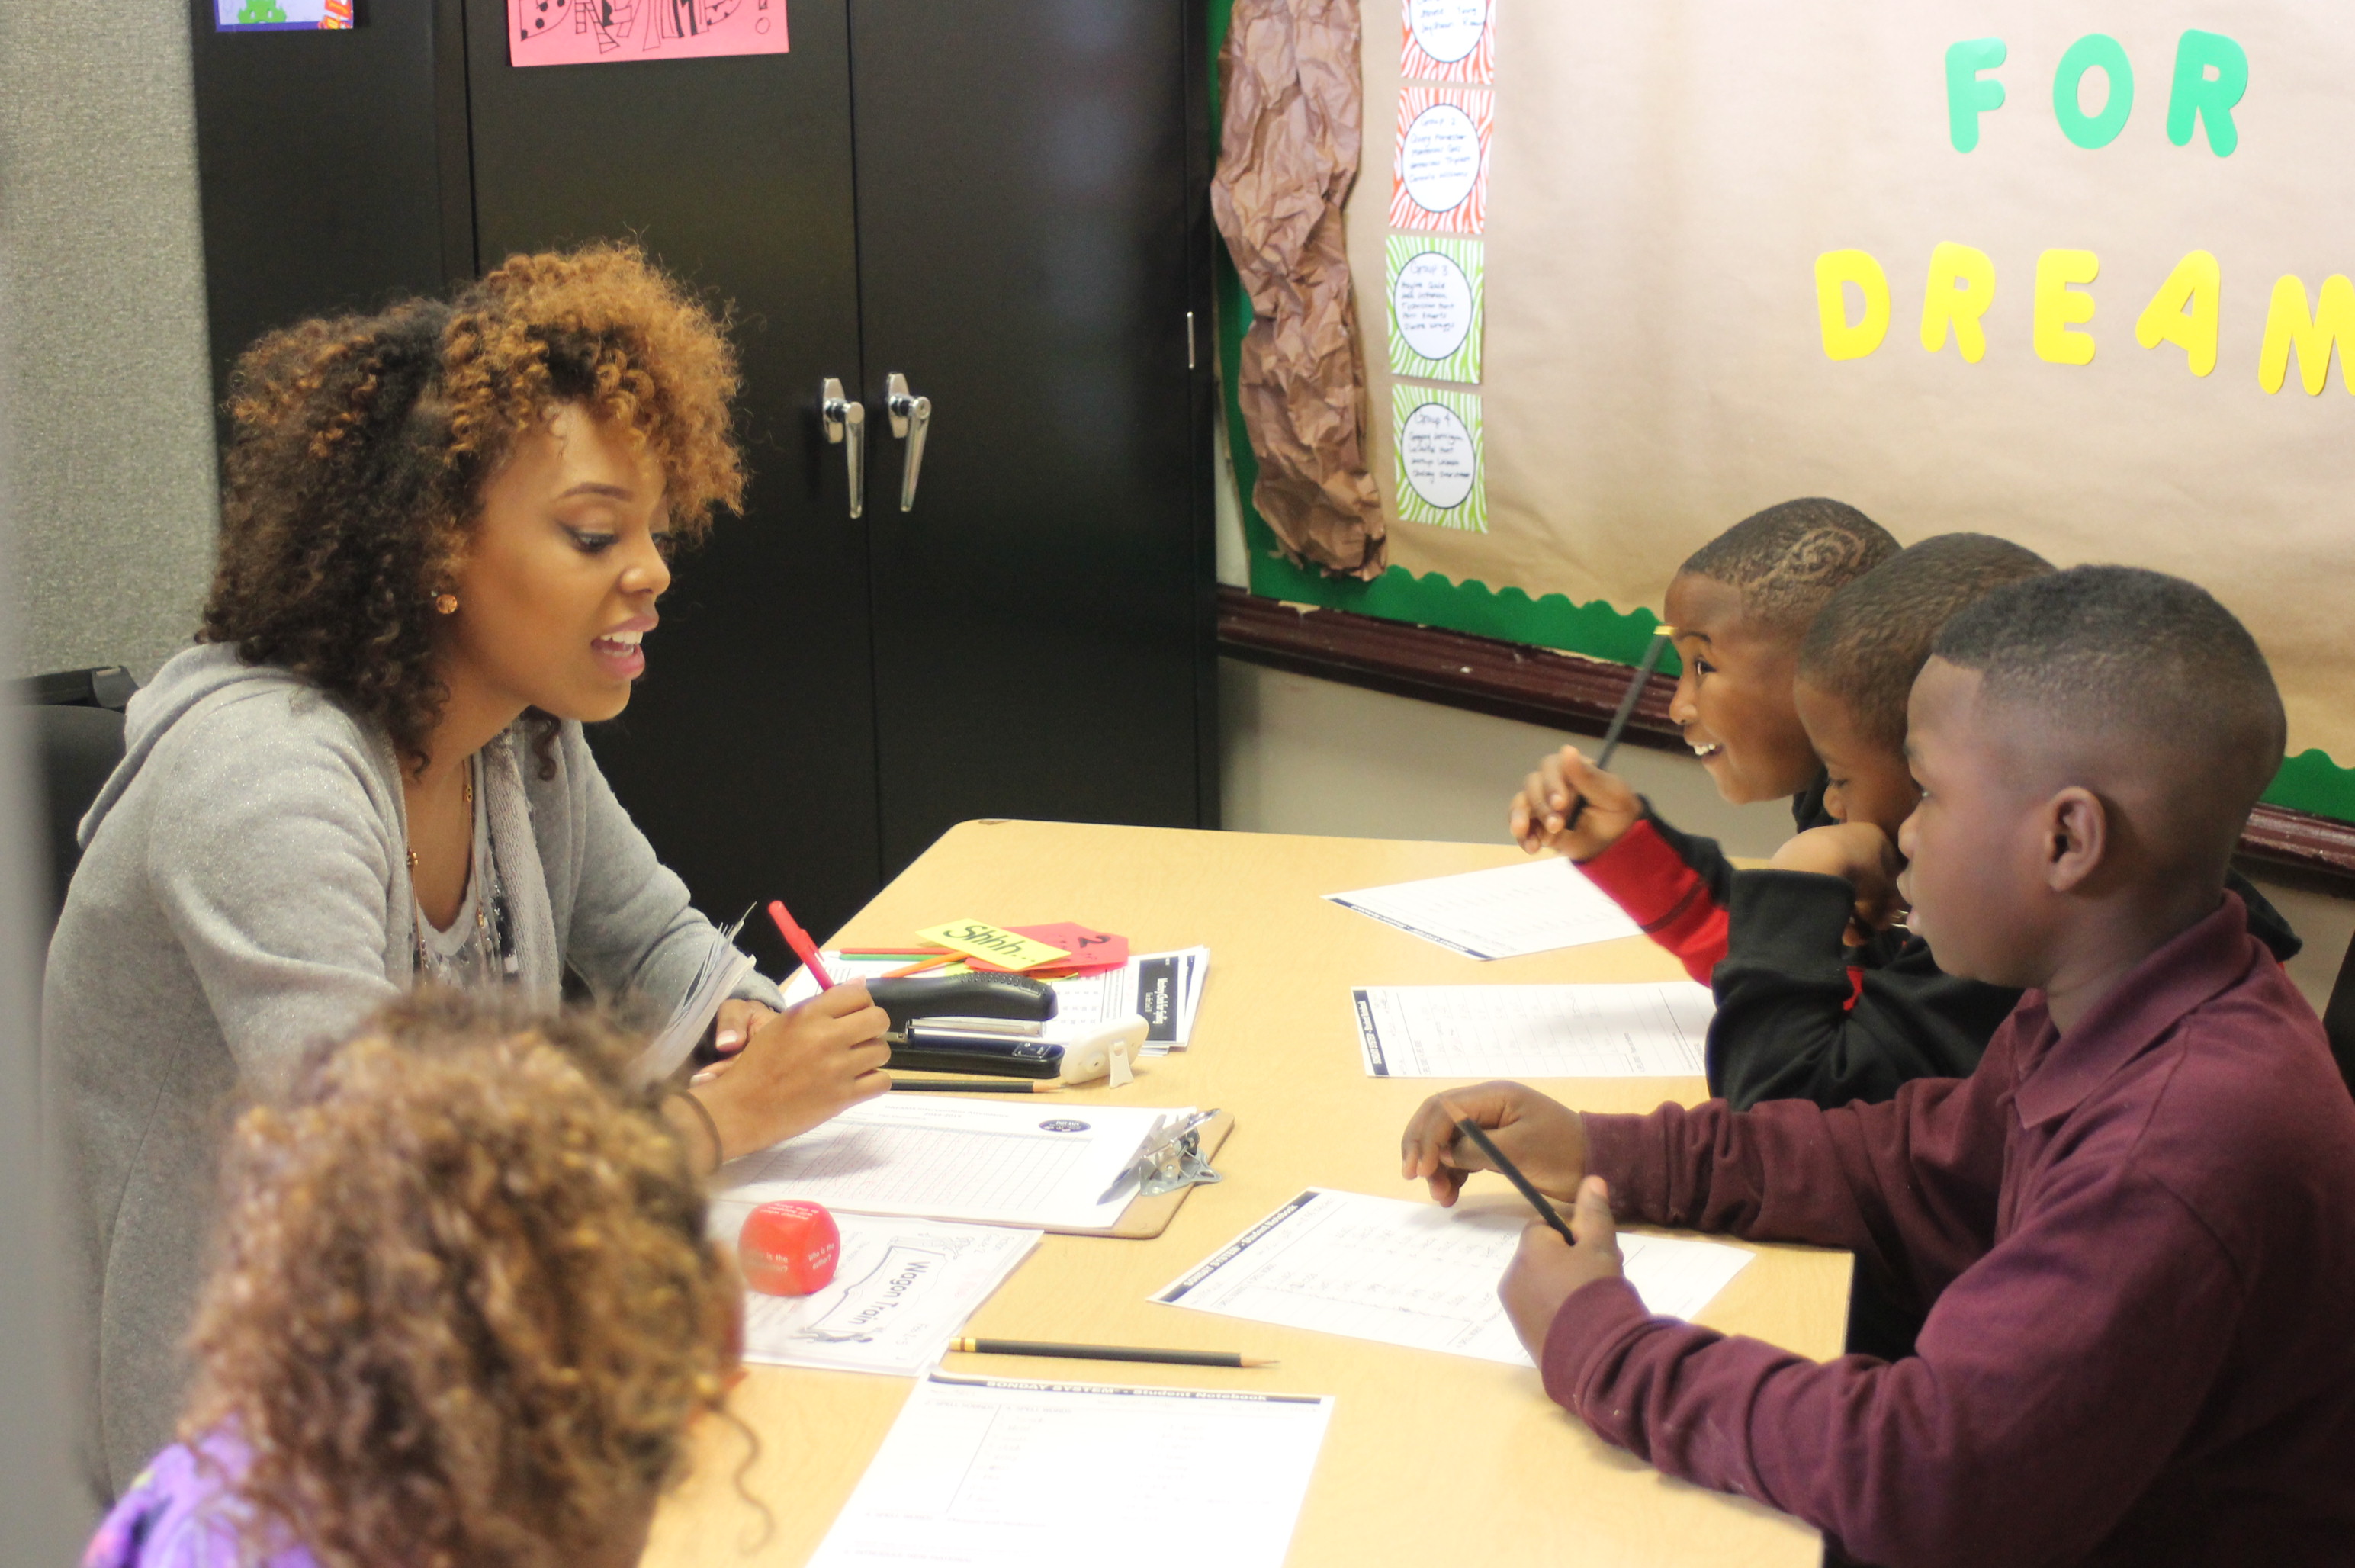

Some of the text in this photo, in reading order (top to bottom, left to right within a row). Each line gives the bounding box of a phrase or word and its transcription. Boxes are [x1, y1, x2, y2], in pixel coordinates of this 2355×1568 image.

[1945, 29, 2249, 158] FOR
[1814, 241, 2355, 397] DREAM
[776, 1254, 789, 1264] the
[848, 1261, 931, 1325] Wagon Train
[987, 1380, 1052, 1390] SONDAY
[1133, 1388, 1191, 1398] Student
[1195, 1392, 1267, 1402] Notebook
